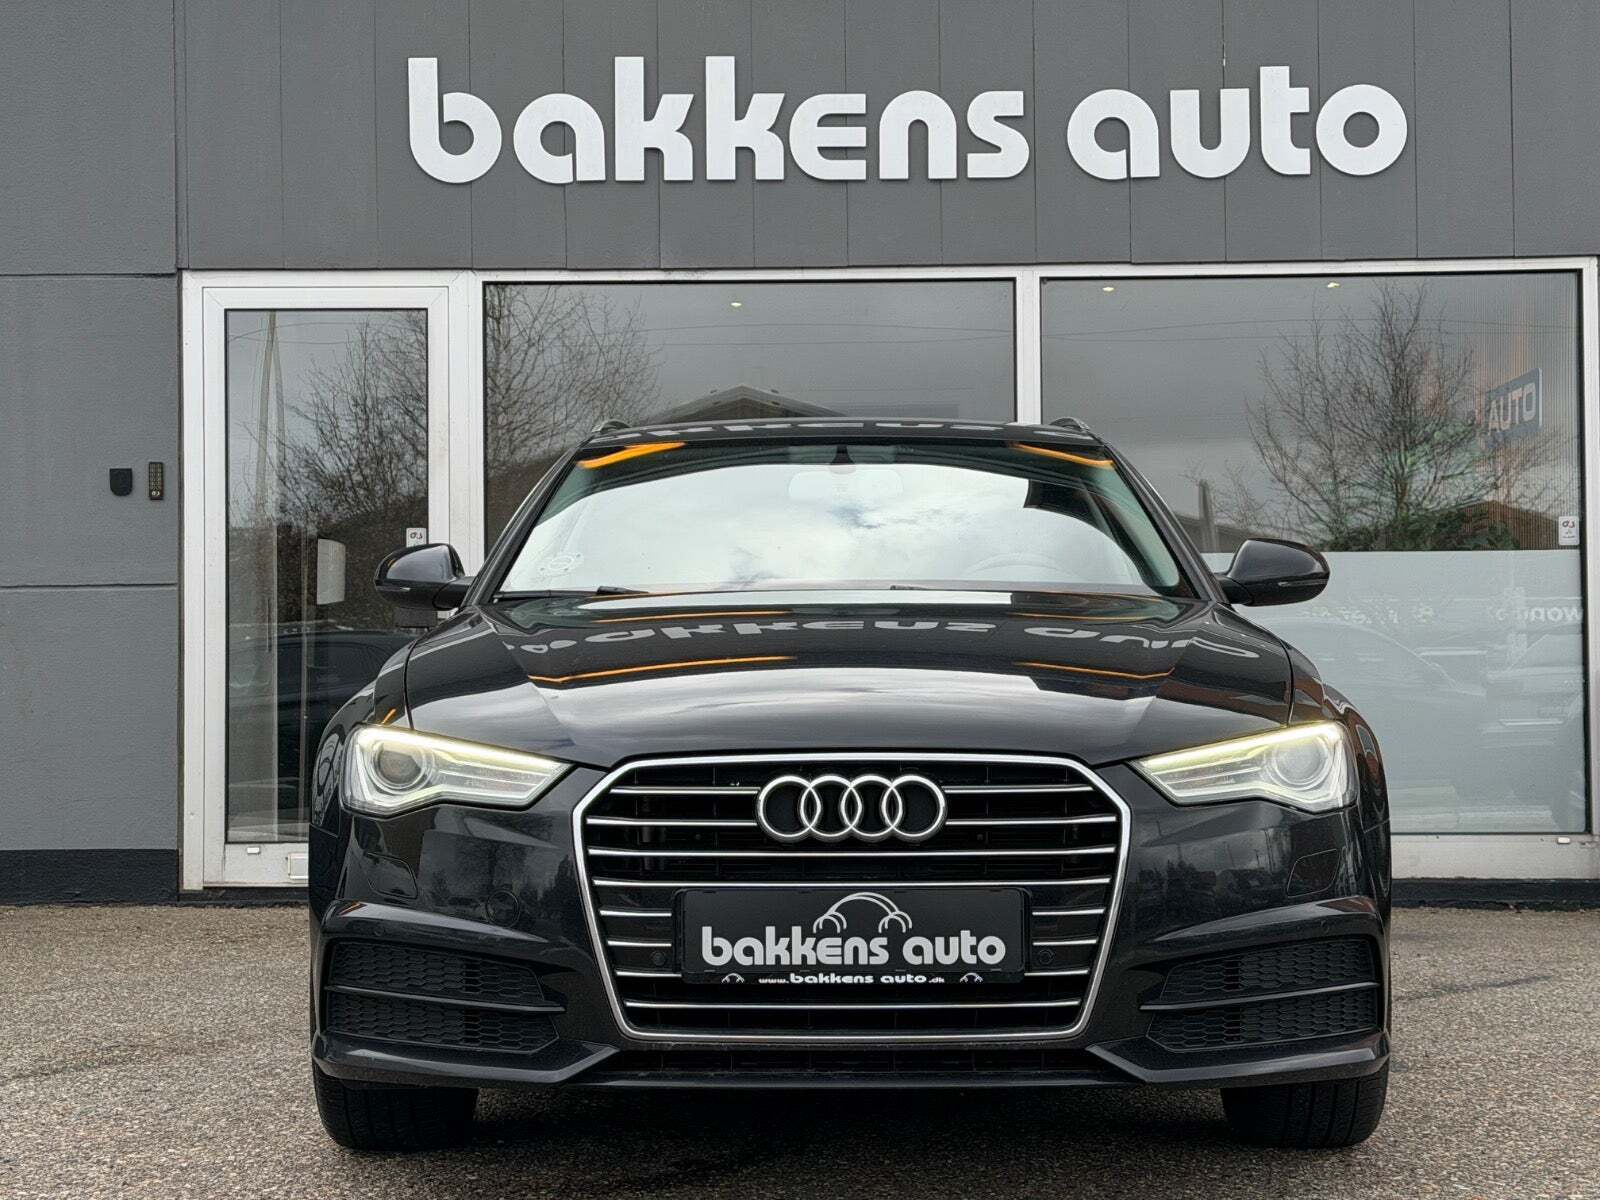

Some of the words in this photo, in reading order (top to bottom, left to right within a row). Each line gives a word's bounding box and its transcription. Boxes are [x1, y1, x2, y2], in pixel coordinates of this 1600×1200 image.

[407, 56, 1030, 184] bakkens
[1066, 65, 1408, 180] auto
[1487, 382, 1538, 436] AUTO
[701, 925, 890, 966] bakkens
[902, 930, 1006, 966] auto
